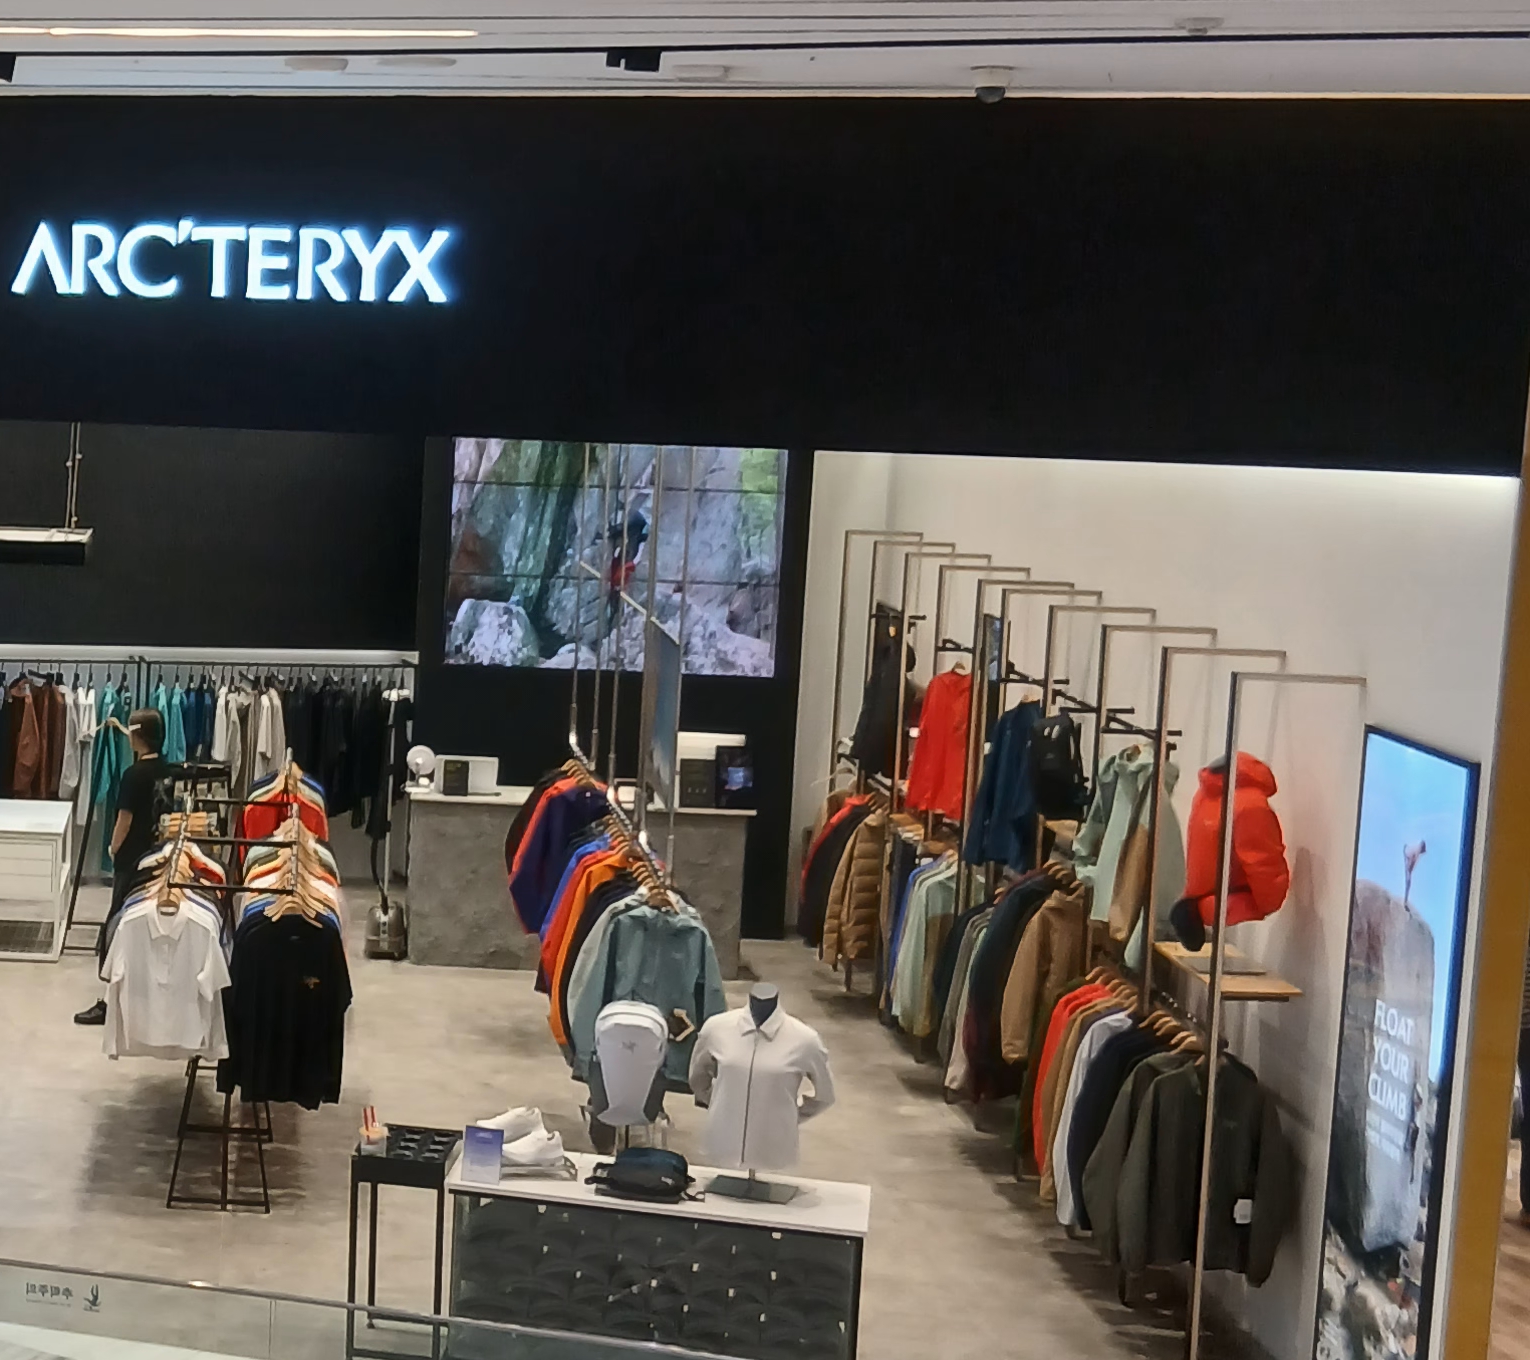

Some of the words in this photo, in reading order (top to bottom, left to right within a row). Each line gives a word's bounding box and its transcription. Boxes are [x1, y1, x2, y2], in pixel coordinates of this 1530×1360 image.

[11, 218, 451, 305] ARC'TERYX
[1374, 998, 1415, 1046] FLOAT
[1372, 1035, 1410, 1084] YOUR
[1367, 1073, 1408, 1121] CLIMB
